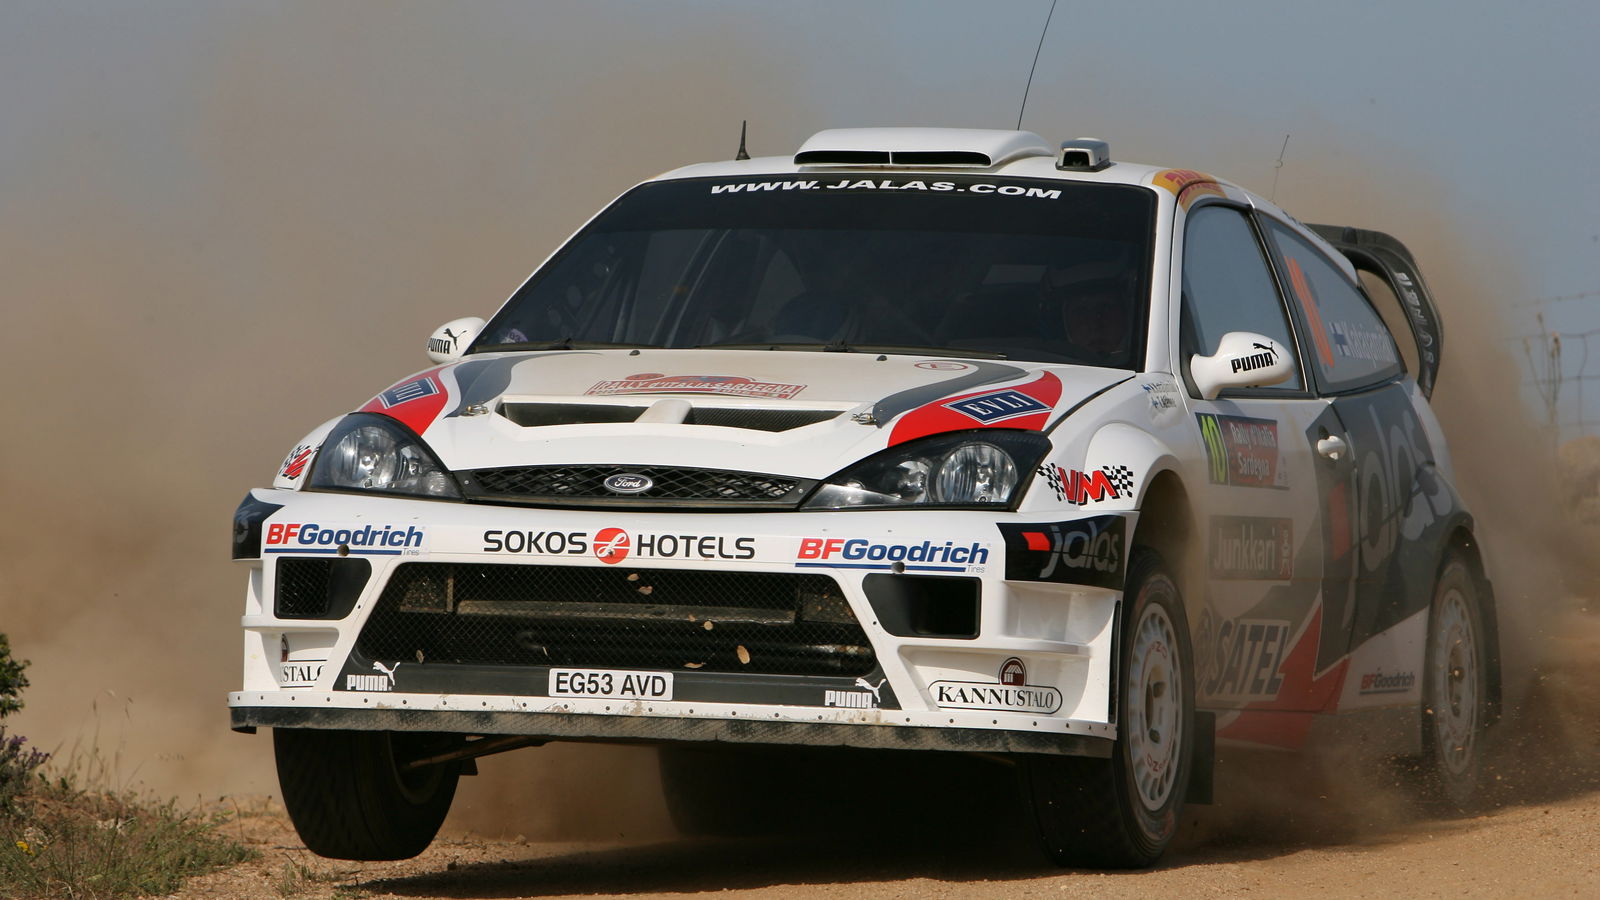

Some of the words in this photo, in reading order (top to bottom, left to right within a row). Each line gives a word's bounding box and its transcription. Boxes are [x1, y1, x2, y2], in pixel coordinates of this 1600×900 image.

[711, 180, 1063, 199] WWW.JALAS.COM
[428, 337, 451, 354] PUMA
[1231, 352, 1274, 373] PUMA
[711, 382, 798, 395] SARDEGNA
[963, 395, 1034, 415] EVLI
[1200, 415, 1227, 482] 10
[614, 476, 641, 487] Ford
[1057, 466, 1119, 505] VM
[266, 523, 424, 547] BFGoodrich
[483, 530, 587, 554] SOKOS
[637, 534, 755, 559] HOTELS
[797, 538, 989, 564] BFGoodrich
[1214, 524, 1276, 571] Junkkari
[966, 564, 985, 573] Tires
[1205, 619, 1290, 695] SATEL
[346, 674, 388, 691] PUMA
[556, 672, 613, 694] EG53
[620, 675, 667, 697] AVD
[824, 690, 873, 708] PUMA
[938, 685, 1054, 708] KANNUSTALO
